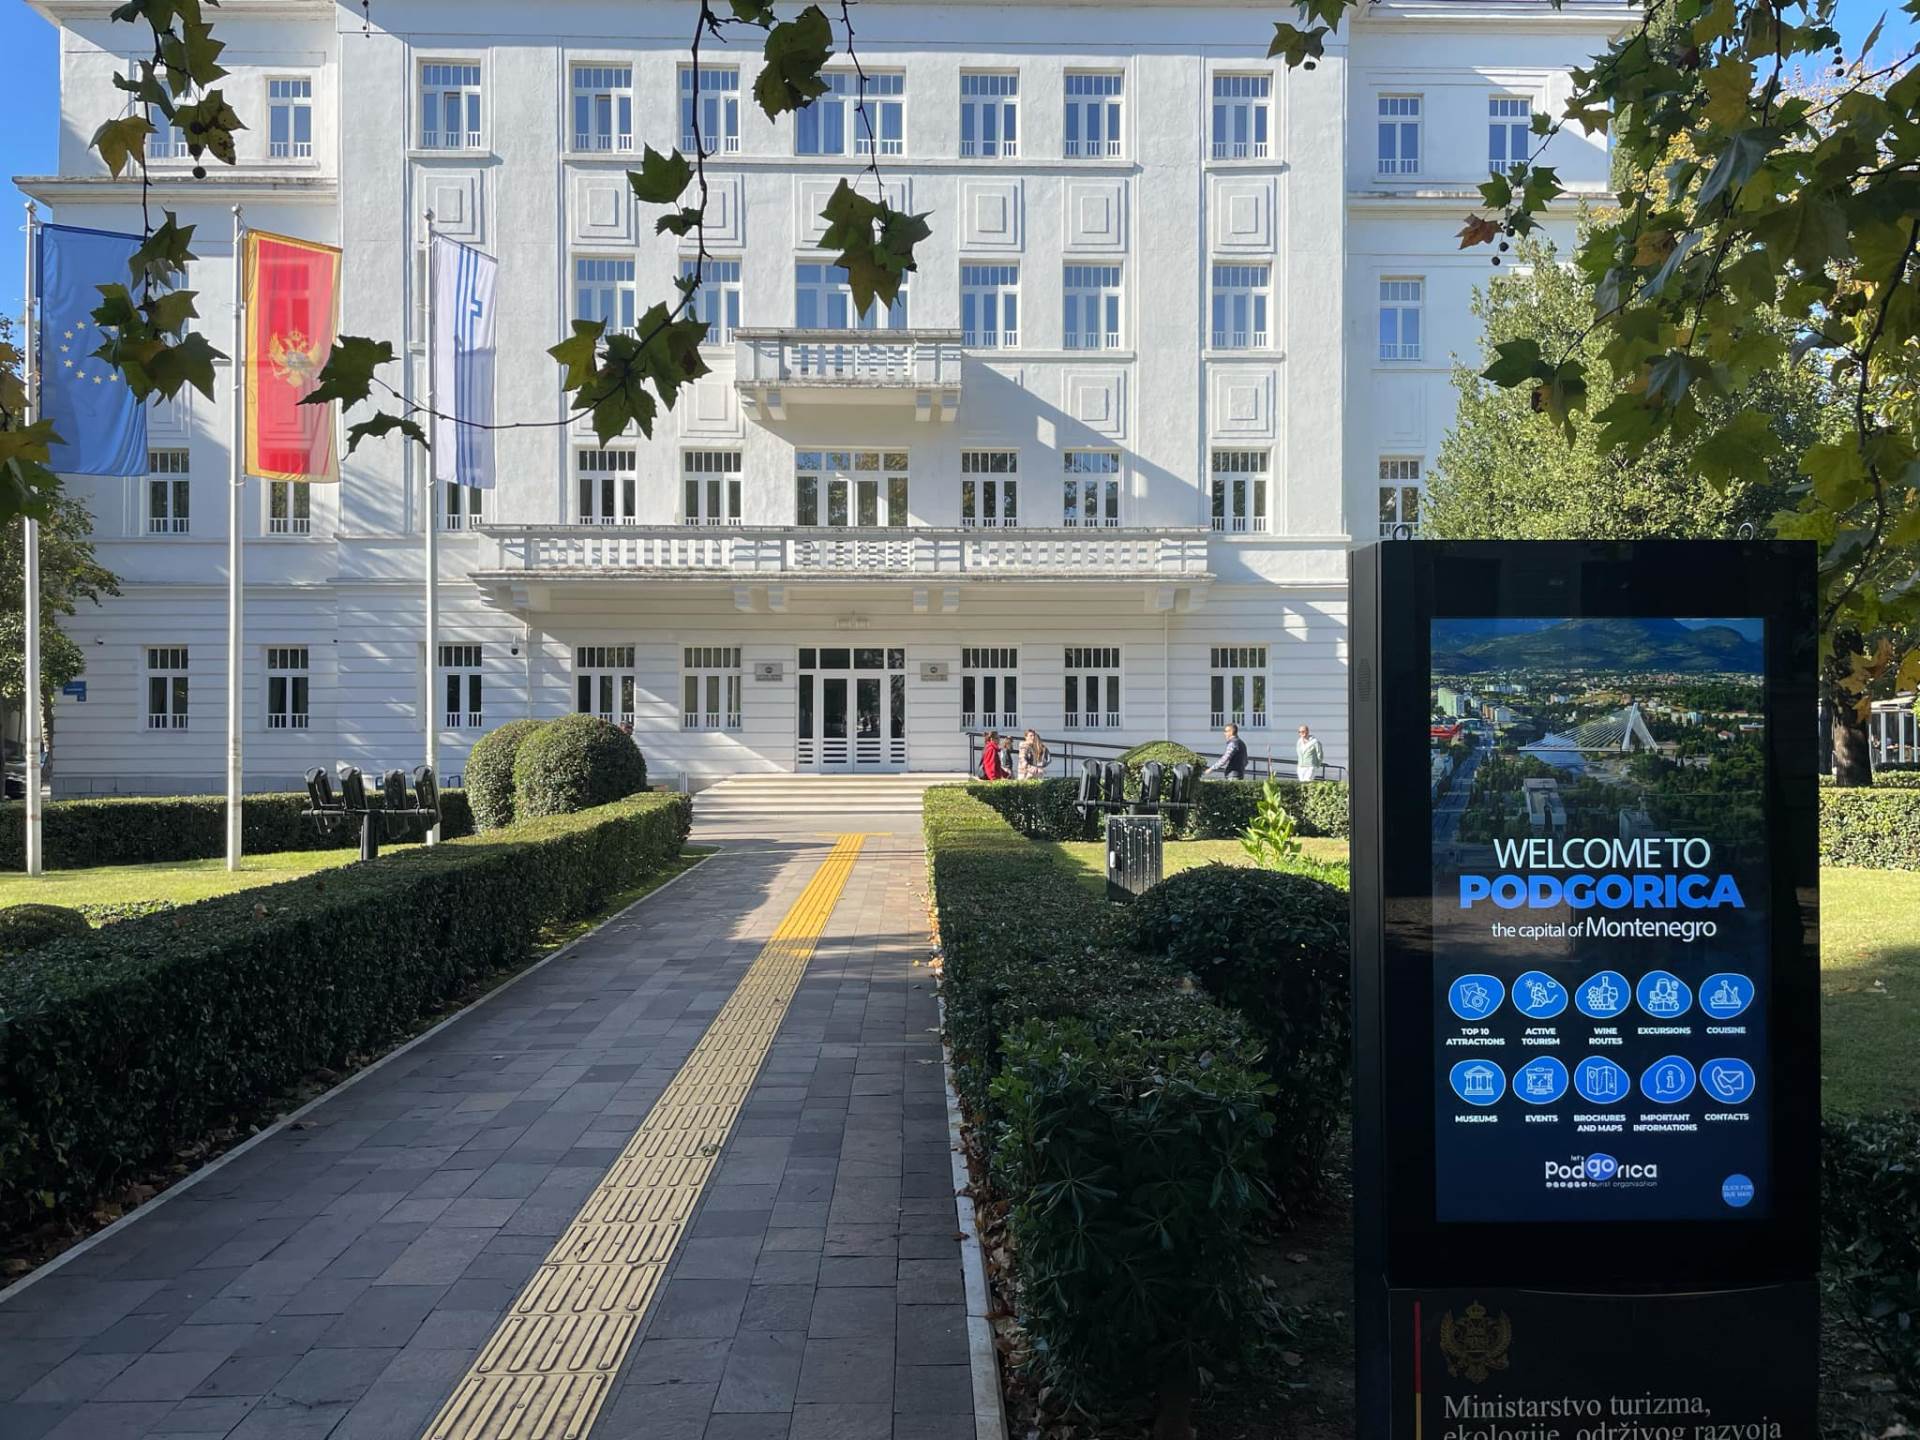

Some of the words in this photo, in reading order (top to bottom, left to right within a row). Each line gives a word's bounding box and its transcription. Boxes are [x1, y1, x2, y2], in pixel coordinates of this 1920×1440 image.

[1493, 837, 1662, 869] WELCOME
[1664, 837, 1711, 868] TO
[1460, 874, 1746, 909] PODGORICA
[1491, 921, 1517, 938] the
[1518, 920, 1566, 941] capital
[1567, 920, 1585, 938] of
[1586, 916, 1718, 943] Montenegro
[1460, 1027, 1480, 1036] TOP
[1480, 1027, 1490, 1036] 10
[1524, 1027, 1557, 1036] ACTIVE
[1593, 1027, 1618, 1035] WINE
[1637, 1026, 1692, 1035] EXCURSIONS
[1445, 1037, 1506, 1046] ATTRACTIONS
[1521, 1037, 1561, 1046] TOURISM
[1588, 1037, 1623, 1045] ROUTES
[1454, 1114, 1498, 1123] MUSEUMS
[1525, 1114, 1559, 1123] EVENTS
[1573, 1114, 1627, 1122] BROCHURES
[1640, 1113, 1691, 1122] IMPORTANT
[1704, 1112, 1750, 1121] CONTACTS
[1576, 1124, 1597, 1132] AND
[1597, 1124, 1623, 1132] MAPS
[1633, 1123, 1698, 1132] INFORMATIONS
[1545, 1159, 1657, 1179] Podgorica
[1443, 1394, 1602, 1419] Ministarstvo
[1609, 1391, 1711, 1417] turizma,
[1694, 1415, 1783, 1440] razvoja
